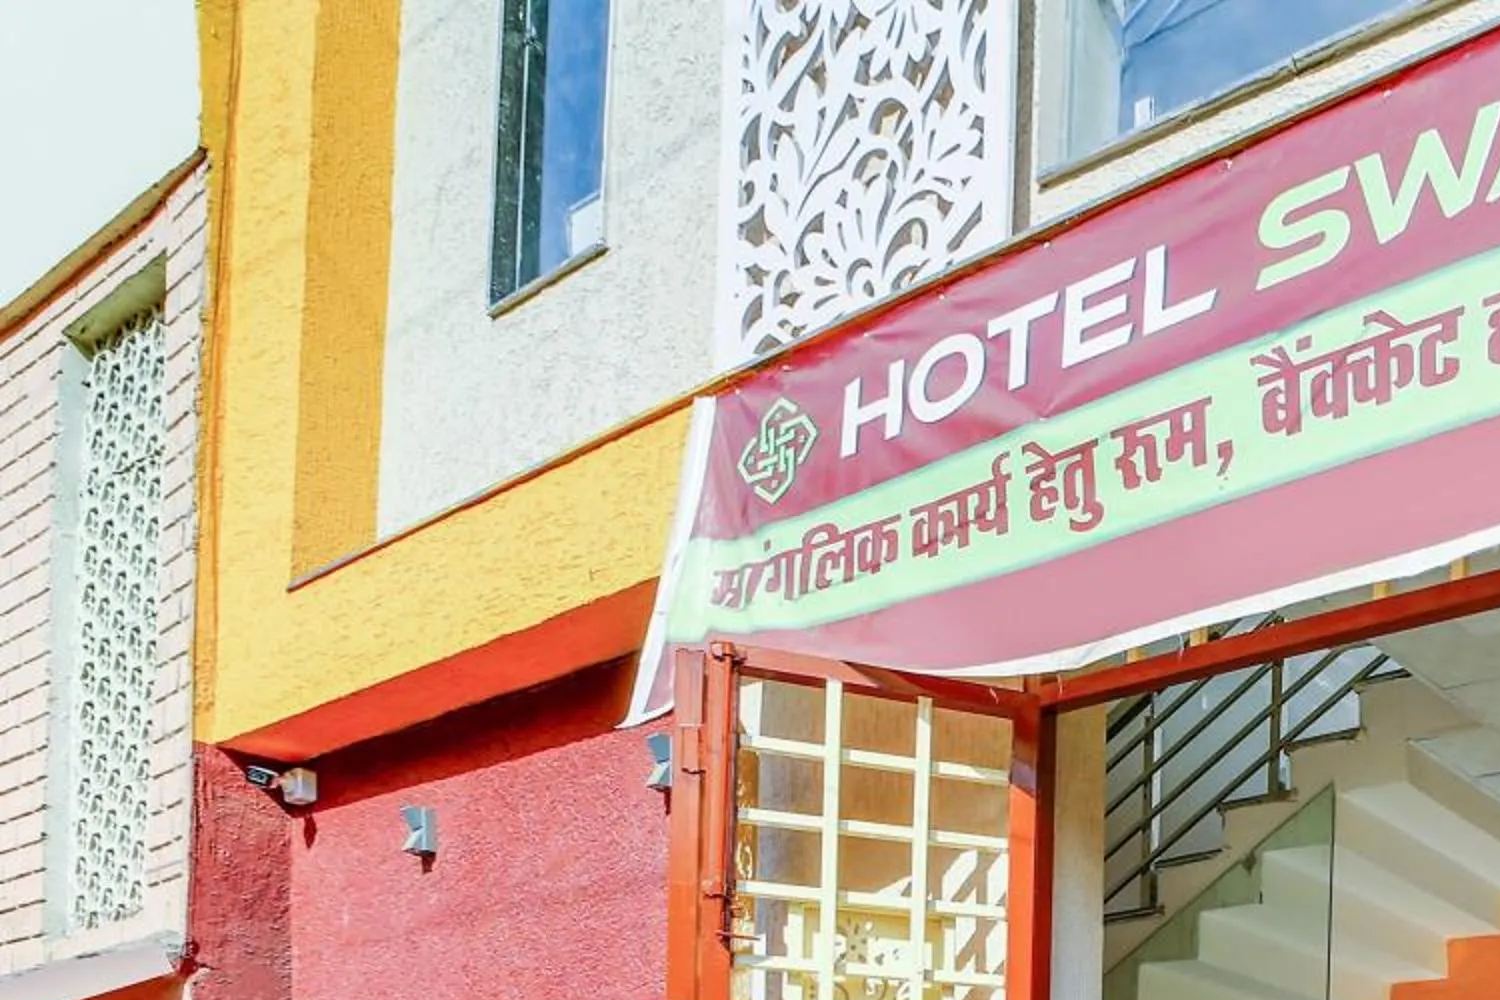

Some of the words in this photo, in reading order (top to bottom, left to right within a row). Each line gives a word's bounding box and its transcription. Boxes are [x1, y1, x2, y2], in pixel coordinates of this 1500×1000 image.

[839, 244, 1217, 459] HOTEL
[710, 513, 901, 610] मांगलिक
[909, 450, 1012, 558] कार्य
[1020, 437, 1105, 533] हेतु
[1109, 395, 1235, 491] रूम,
